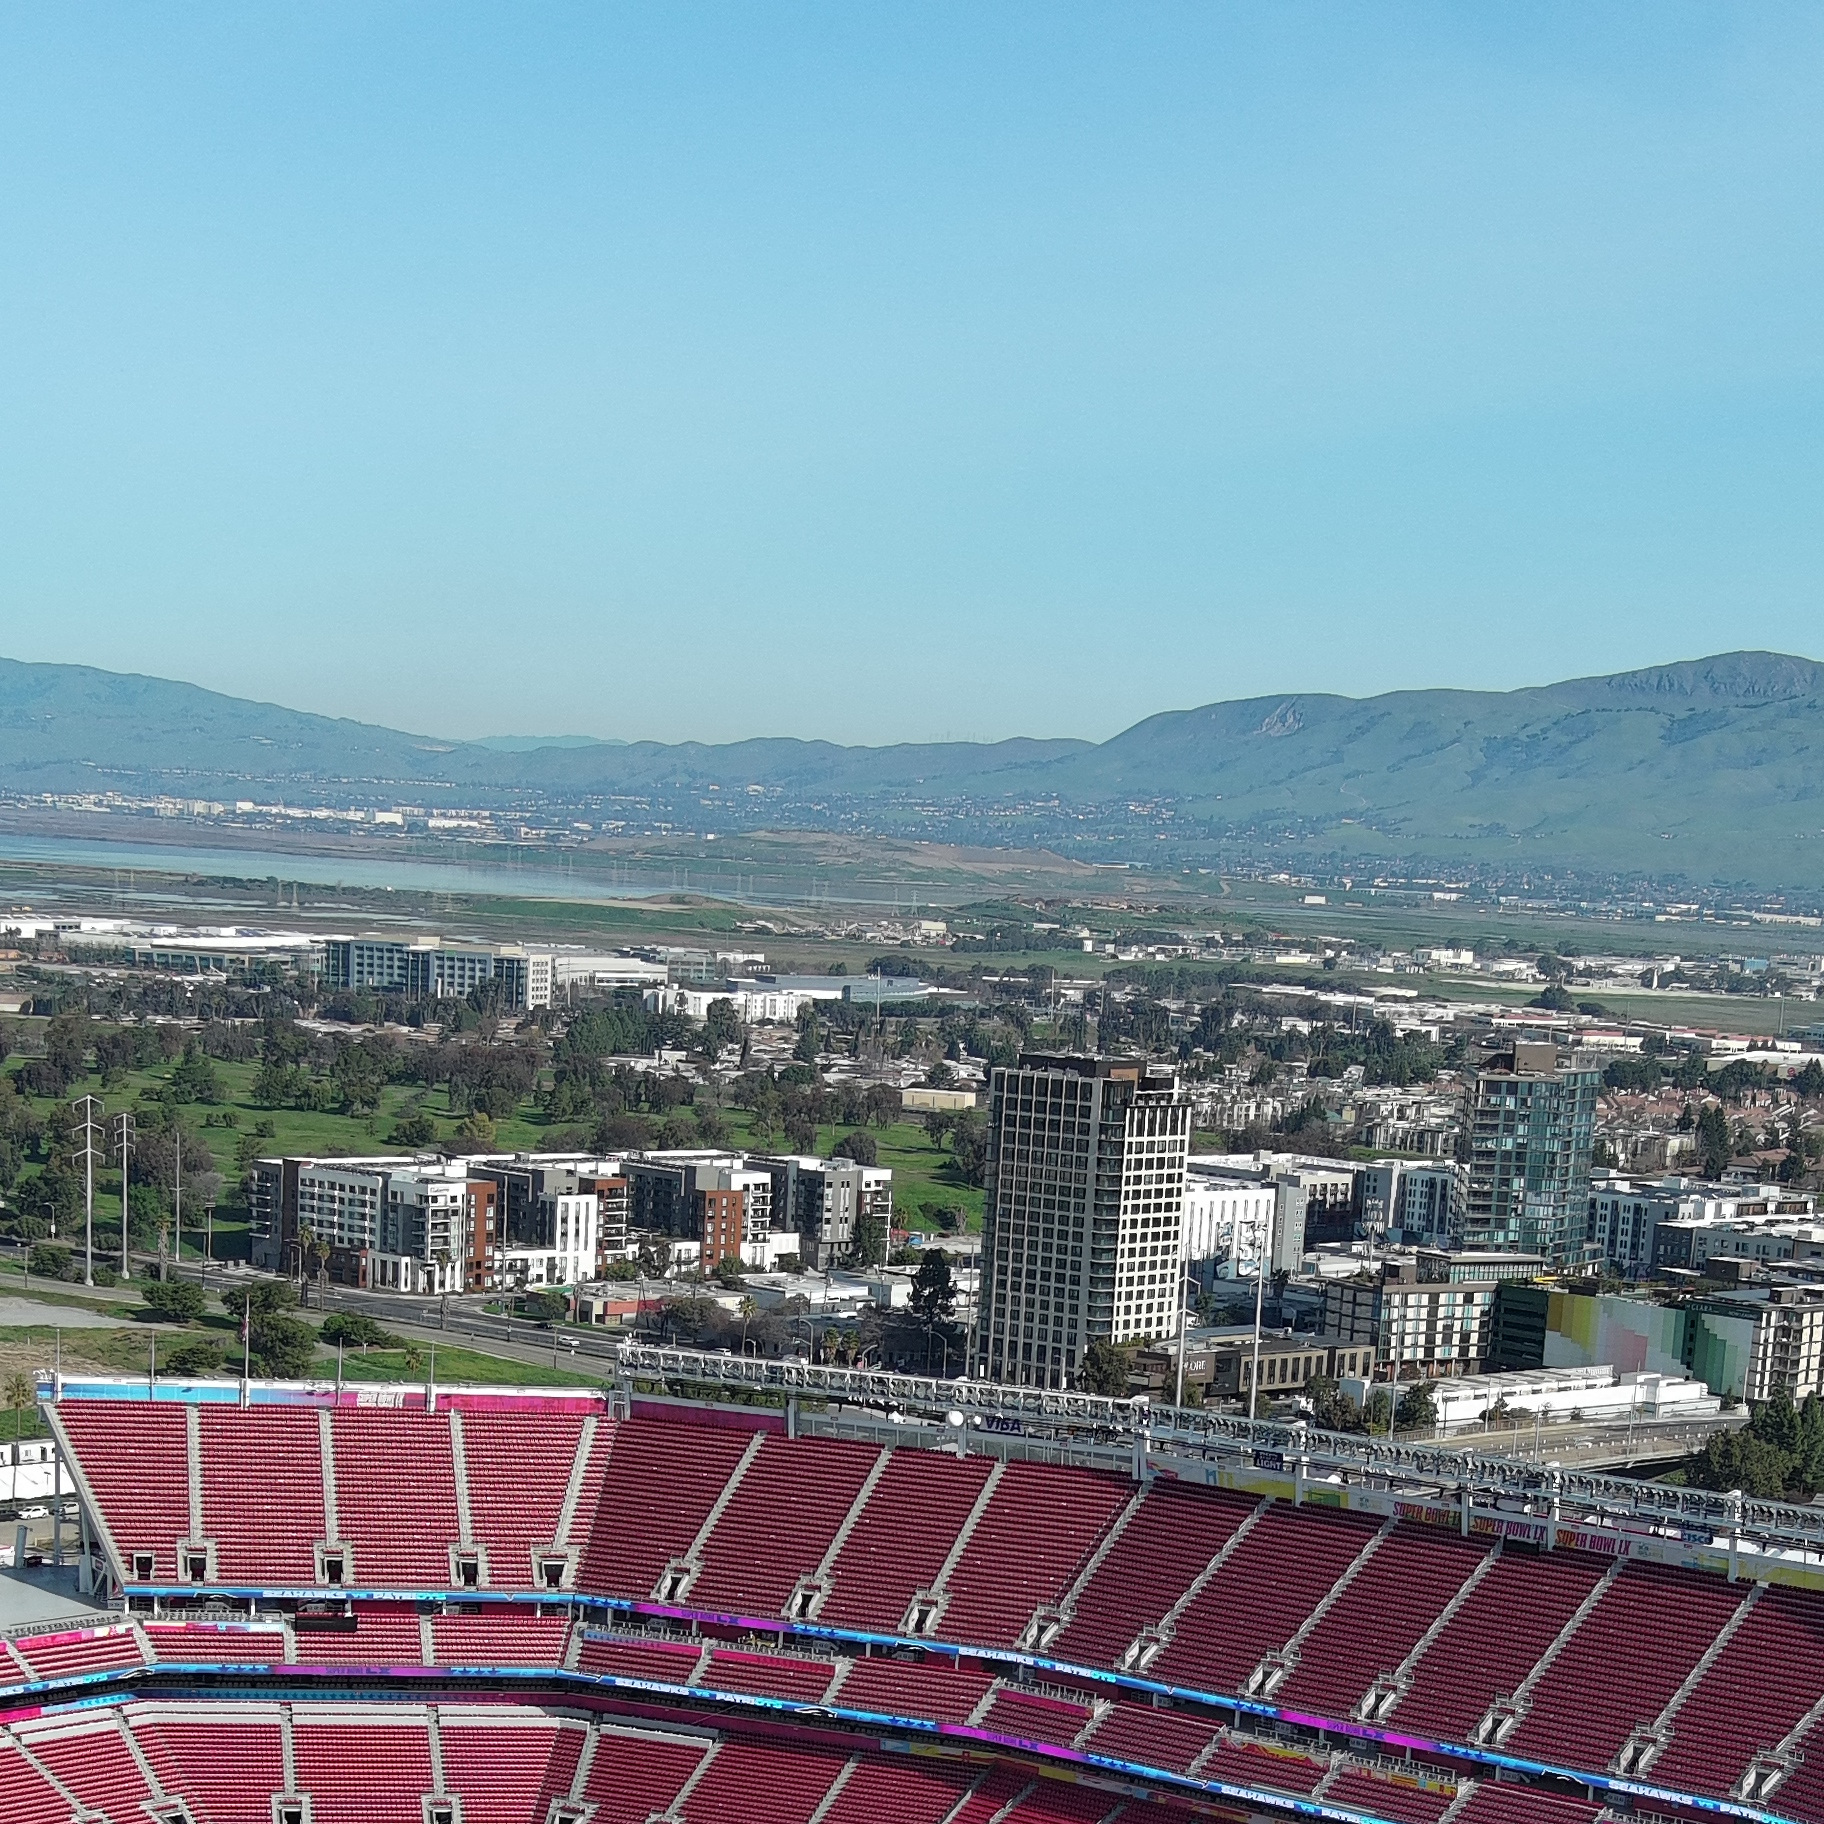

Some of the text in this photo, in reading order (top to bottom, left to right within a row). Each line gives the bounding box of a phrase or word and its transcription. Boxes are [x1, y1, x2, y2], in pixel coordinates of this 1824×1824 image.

[1393, 1502, 1422, 1522] SUPER
[1473, 1517, 1545, 1541] SUPER BOWL LX
[1556, 1529, 1631, 1555] SUPER BOWL LX
[263, 1590, 446, 1600] SEAHAWKS PATRIOTS
[959, 1648, 1116, 1683] SEAHAWKS PATRIOTS
[615, 1680, 782, 1709] SEAHAWKS PATRIOTS
[1221, 1786, 1294, 1809] SEAHAWKS
[1608, 1781, 1692, 1805] SEAHAWKS
